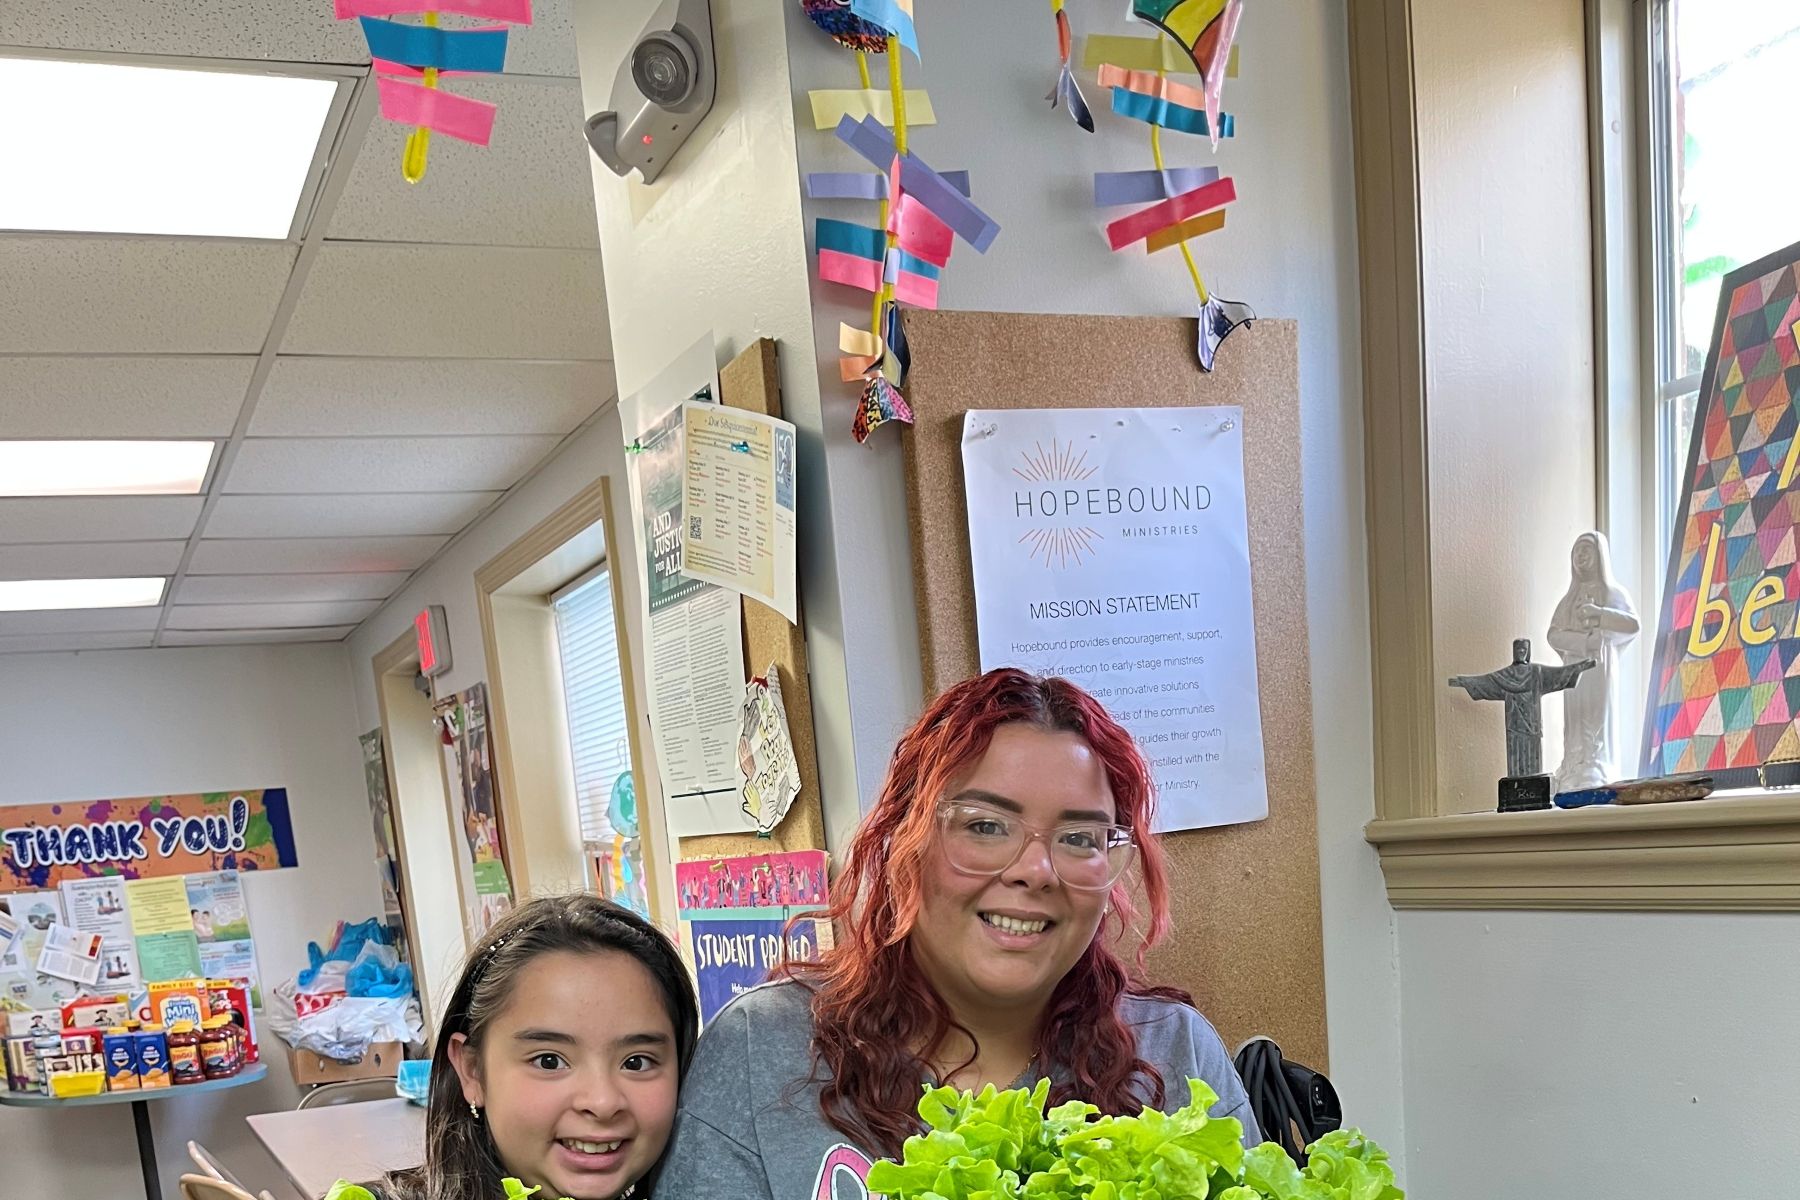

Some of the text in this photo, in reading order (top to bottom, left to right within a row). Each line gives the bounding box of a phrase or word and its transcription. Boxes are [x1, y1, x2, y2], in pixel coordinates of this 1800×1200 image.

[1015, 485, 1211, 517] HOPEBOUND
[653, 511, 671, 538] AND
[1122, 525, 1198, 537] MINISTRIES
[654, 525, 682, 558] JUSTIC
[1030, 593, 1200, 619] MISSION STATEMENT
[1011, 629, 1222, 653] Hopebound provides encouragement, support,
[1036, 655, 1204, 677] and direction to early-stage ministries
[1088, 681, 1199, 698] reate innovative solutions
[1109, 704, 1215, 722] eeds of the communities
[1139, 732, 1168, 746] guides
[1171, 730, 1189, 740] their
[1191, 728, 1222, 741] growth
[1150, 752, 1220, 767] instilled with the
[3, 798, 248, 866] THANK YOU!
[697, 934, 756, 969] STUDENT
[165, 1004, 196, 1018] Mini
